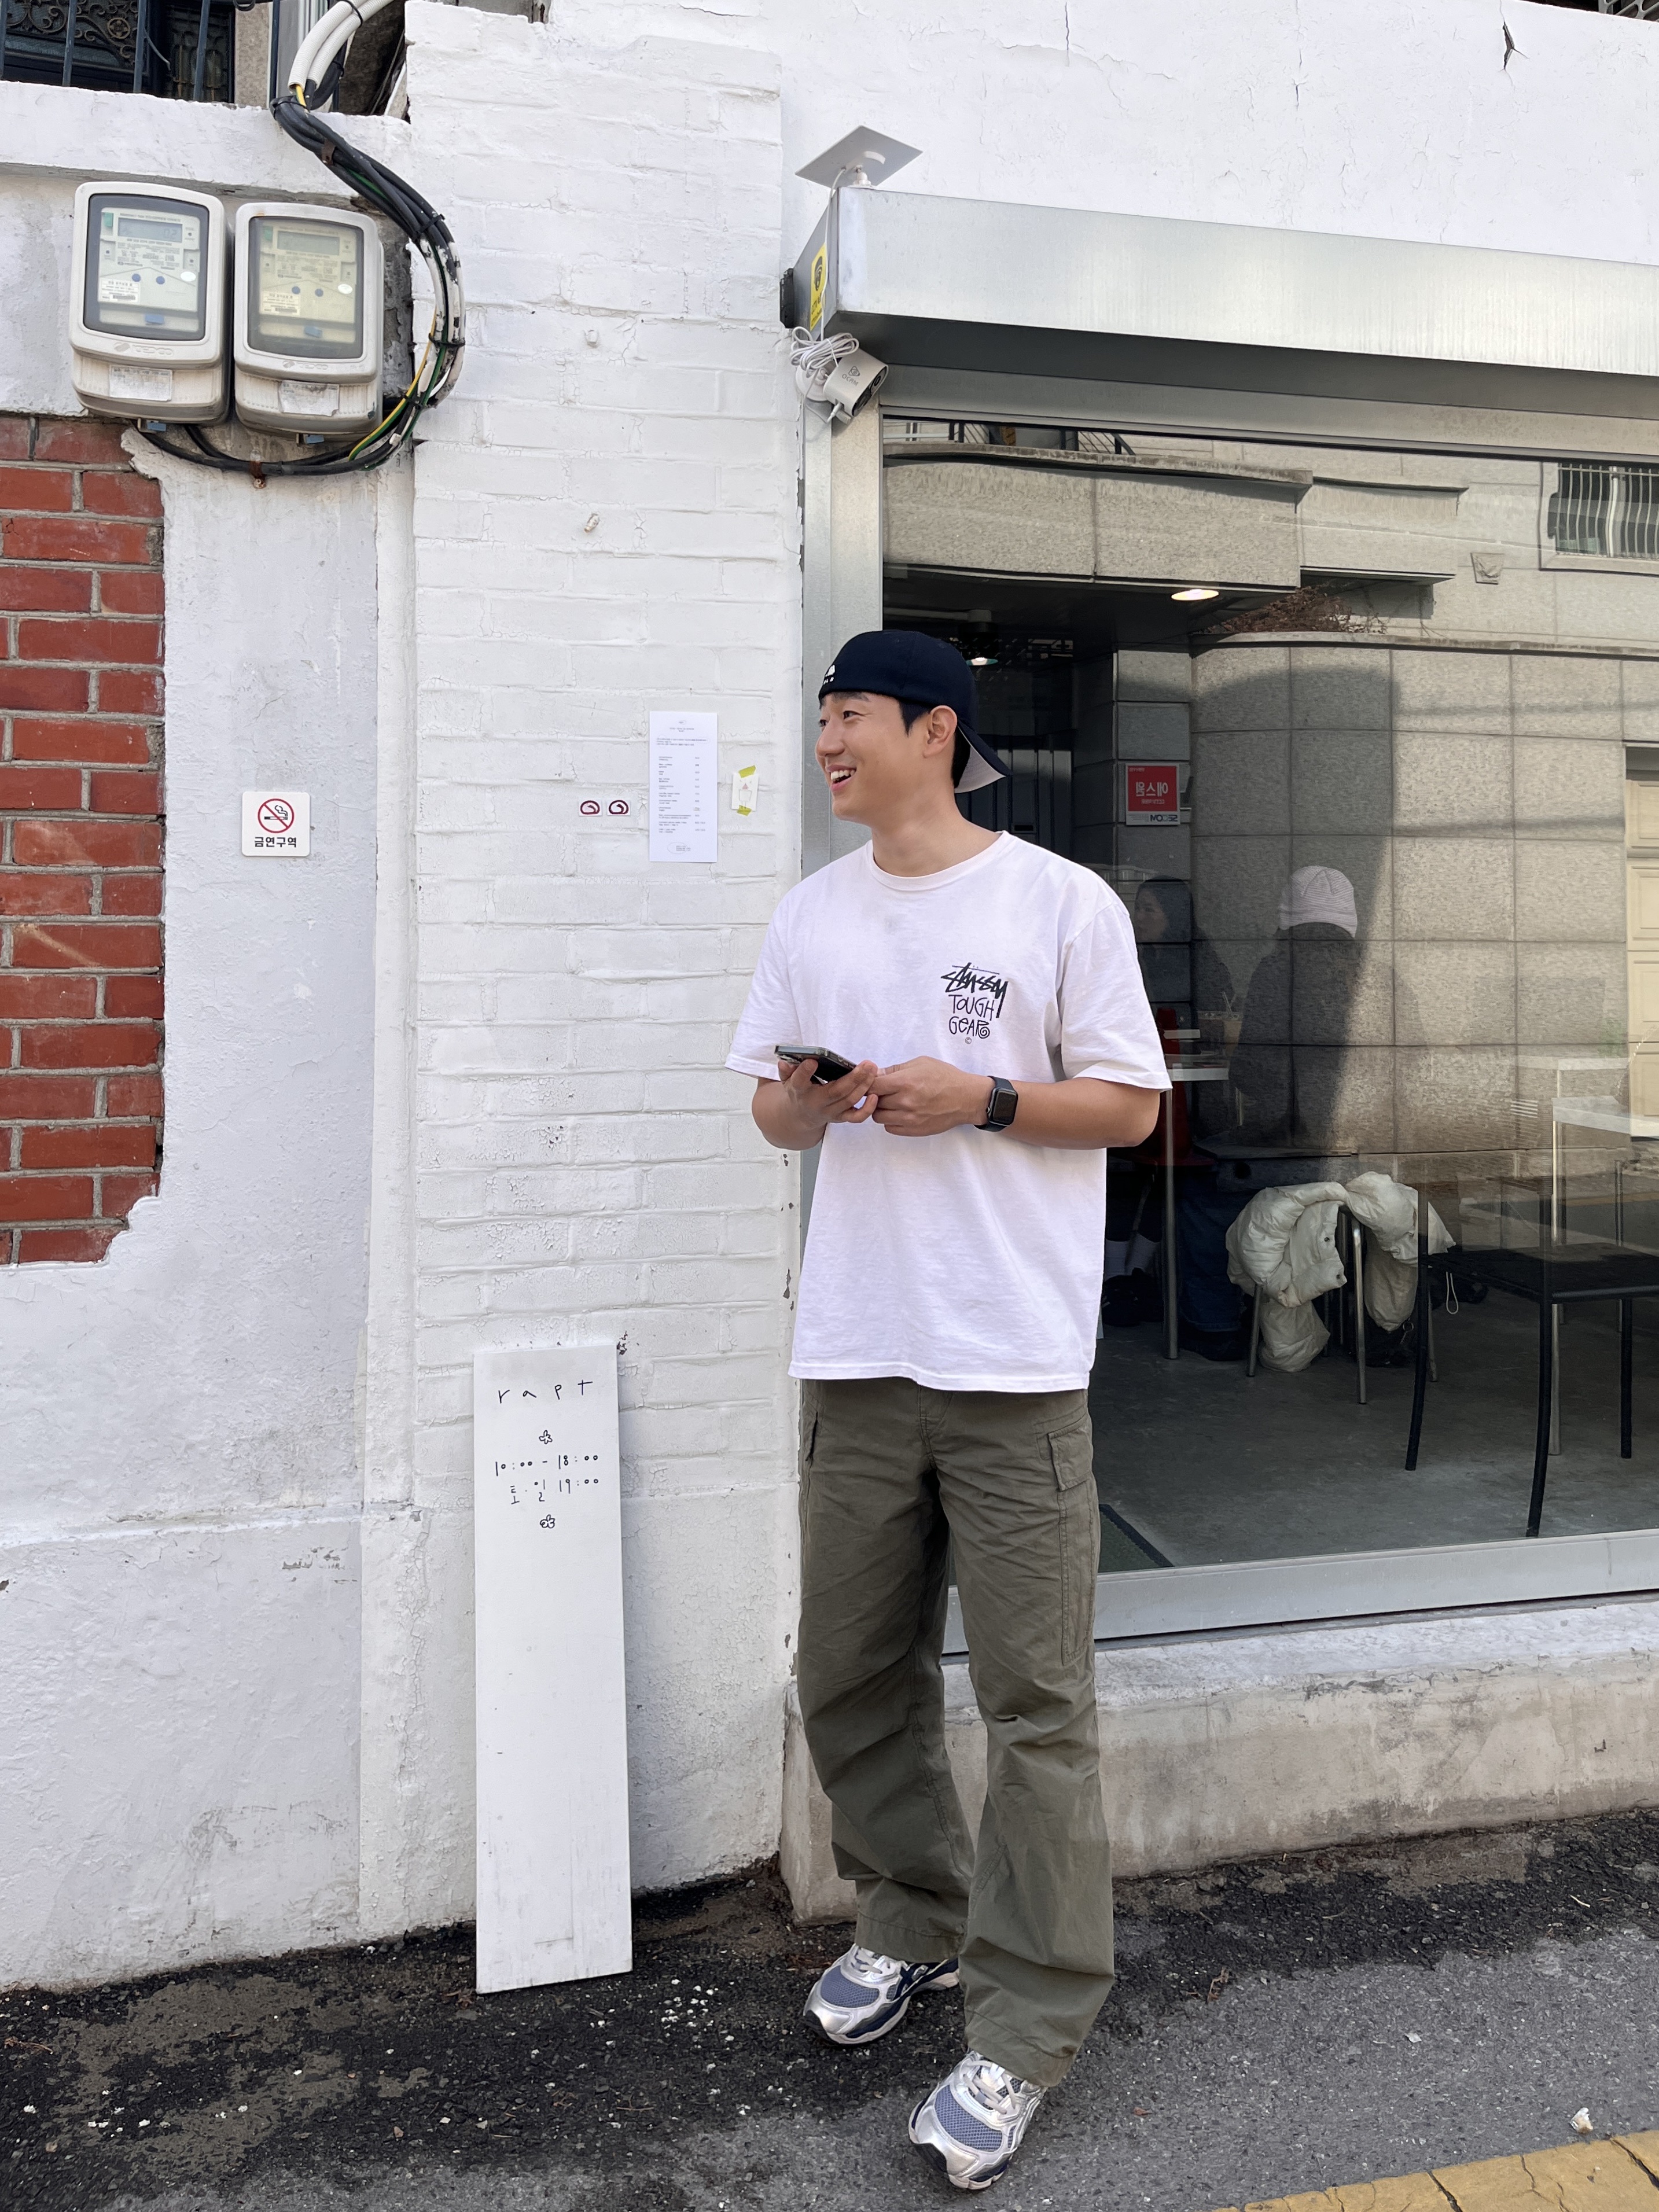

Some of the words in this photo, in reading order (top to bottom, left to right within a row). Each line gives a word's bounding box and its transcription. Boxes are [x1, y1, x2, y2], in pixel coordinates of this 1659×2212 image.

[842, 374, 859, 386] OCAM
[254, 837, 297, 848] 금연구역
[948, 994, 995, 1021] TOUGH
[558, 1455, 598, 1470] 18:00
[559, 1478, 599, 1495] 19:00
